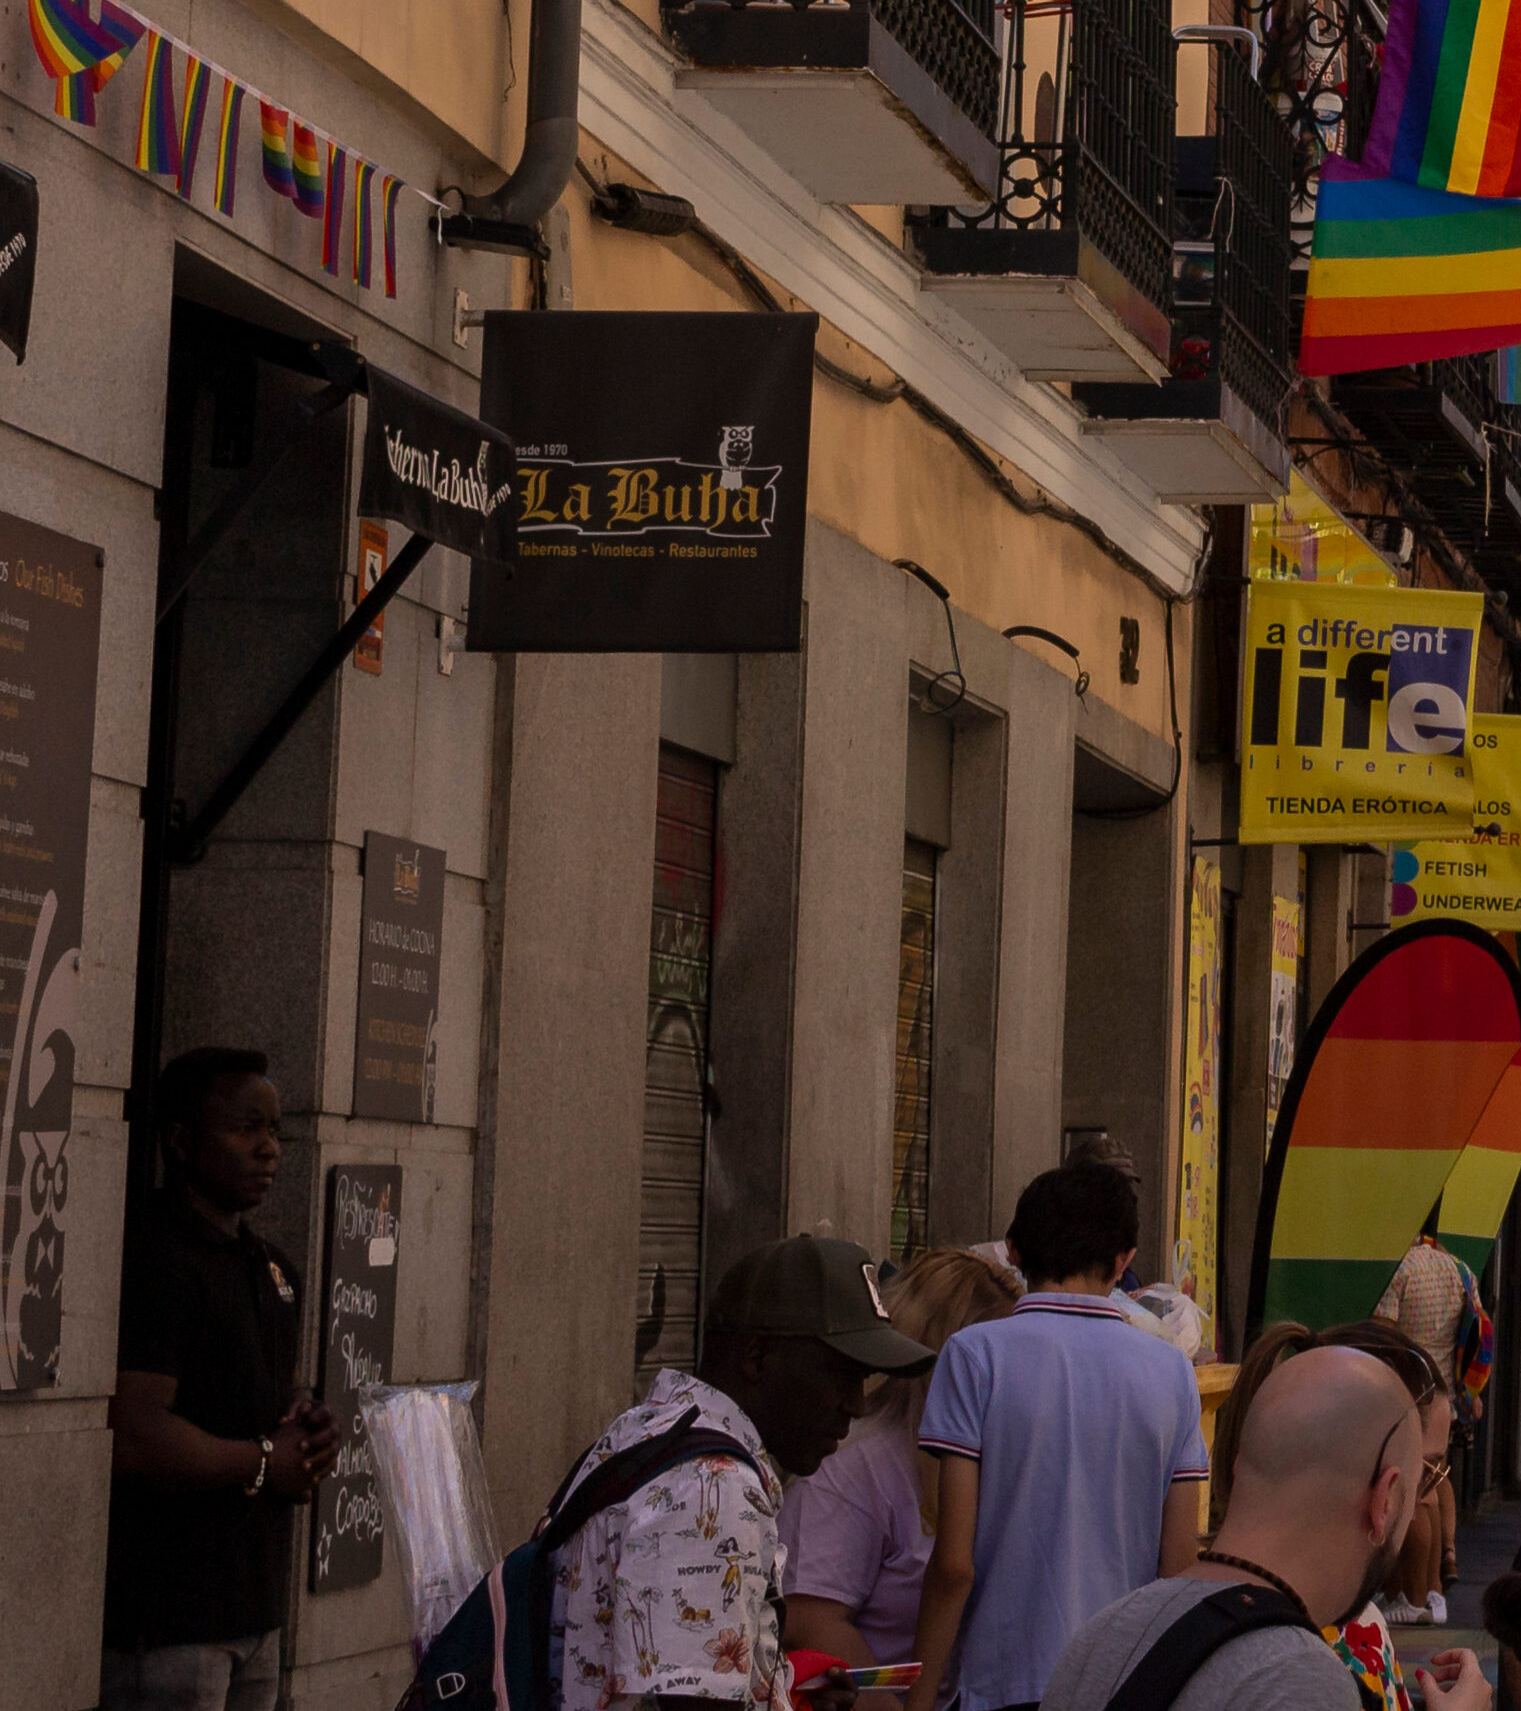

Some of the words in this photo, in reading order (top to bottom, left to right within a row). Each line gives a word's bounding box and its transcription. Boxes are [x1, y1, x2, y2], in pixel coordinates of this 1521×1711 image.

[543, 443, 568, 458] 1970
[516, 467, 592, 526] La
[607, 465, 761, 532] Buha
[517, 541, 577, 558] Tabernas
[591, 541, 655, 558] Vinotecas
[668, 541, 758, 559] Restaurantes
[1266, 622, 1286, 645] a
[1297, 618, 1449, 656] different
[1250, 646, 1468, 756] life
[1249, 754, 1466, 780] librería
[1265, 796, 1345, 815] TIENDA
[1351, 795, 1449, 815] ERÓTICA
[1424, 860, 1488, 878] FETISH
[677, 1565, 723, 1577] HOWDY
